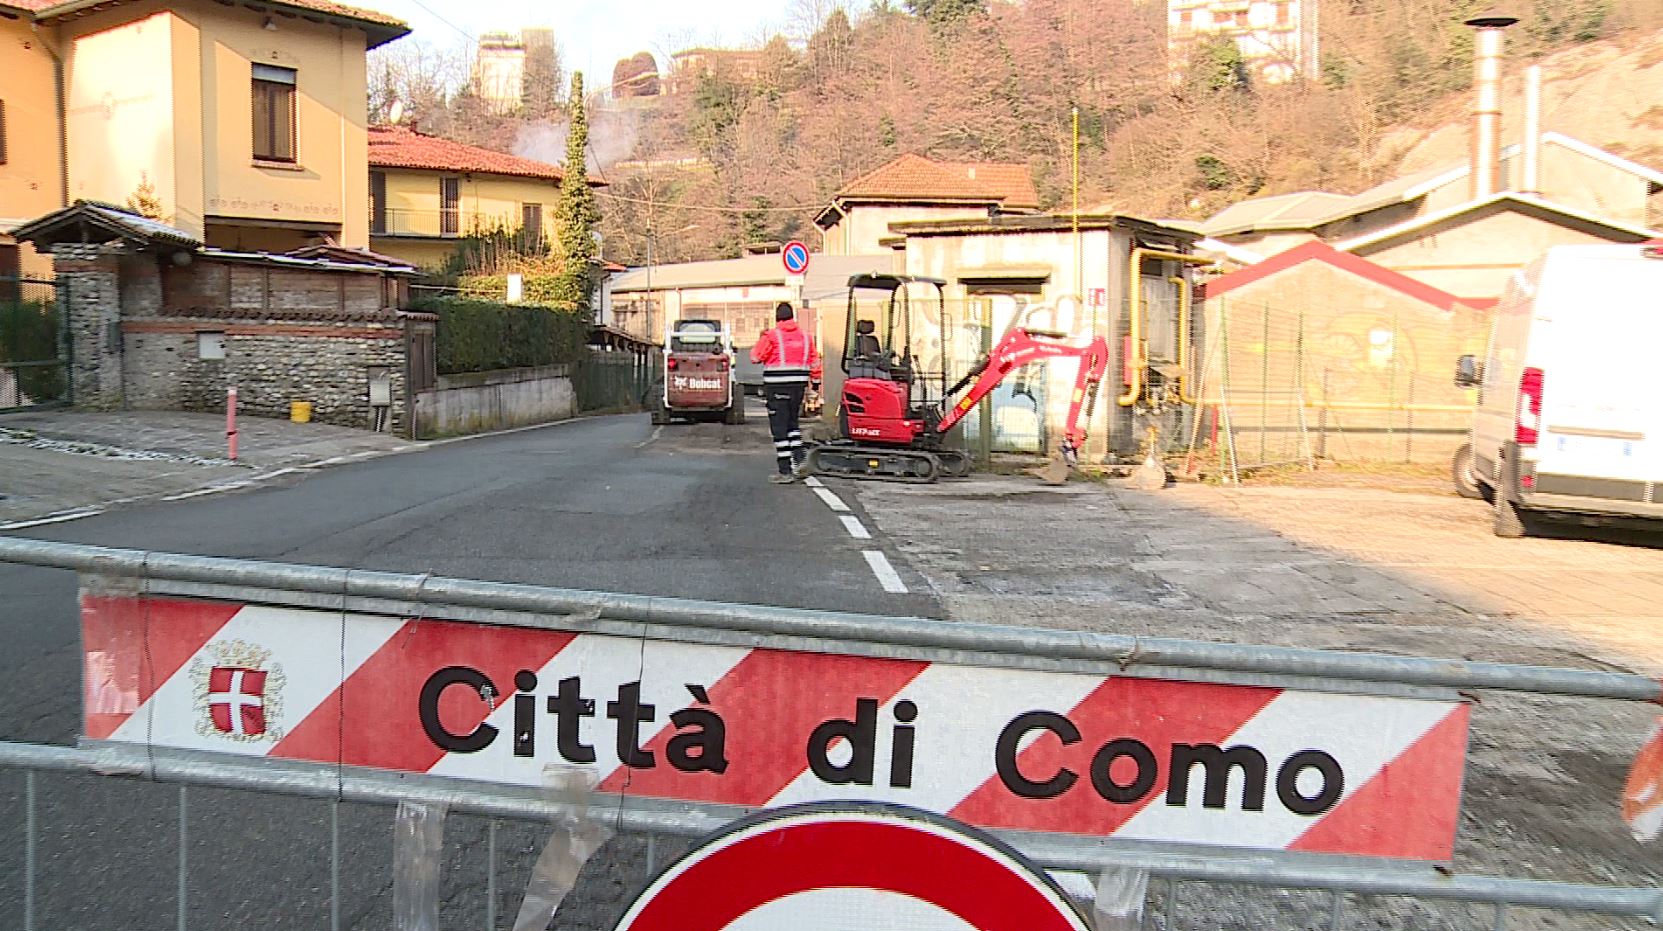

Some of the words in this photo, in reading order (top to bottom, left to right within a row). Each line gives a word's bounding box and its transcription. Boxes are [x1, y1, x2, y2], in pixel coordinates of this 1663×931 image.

[689, 378, 721, 389] Bobcat
[419, 666, 729, 774] Città
[807, 698, 918, 788] di
[995, 710, 1344, 815] Como
